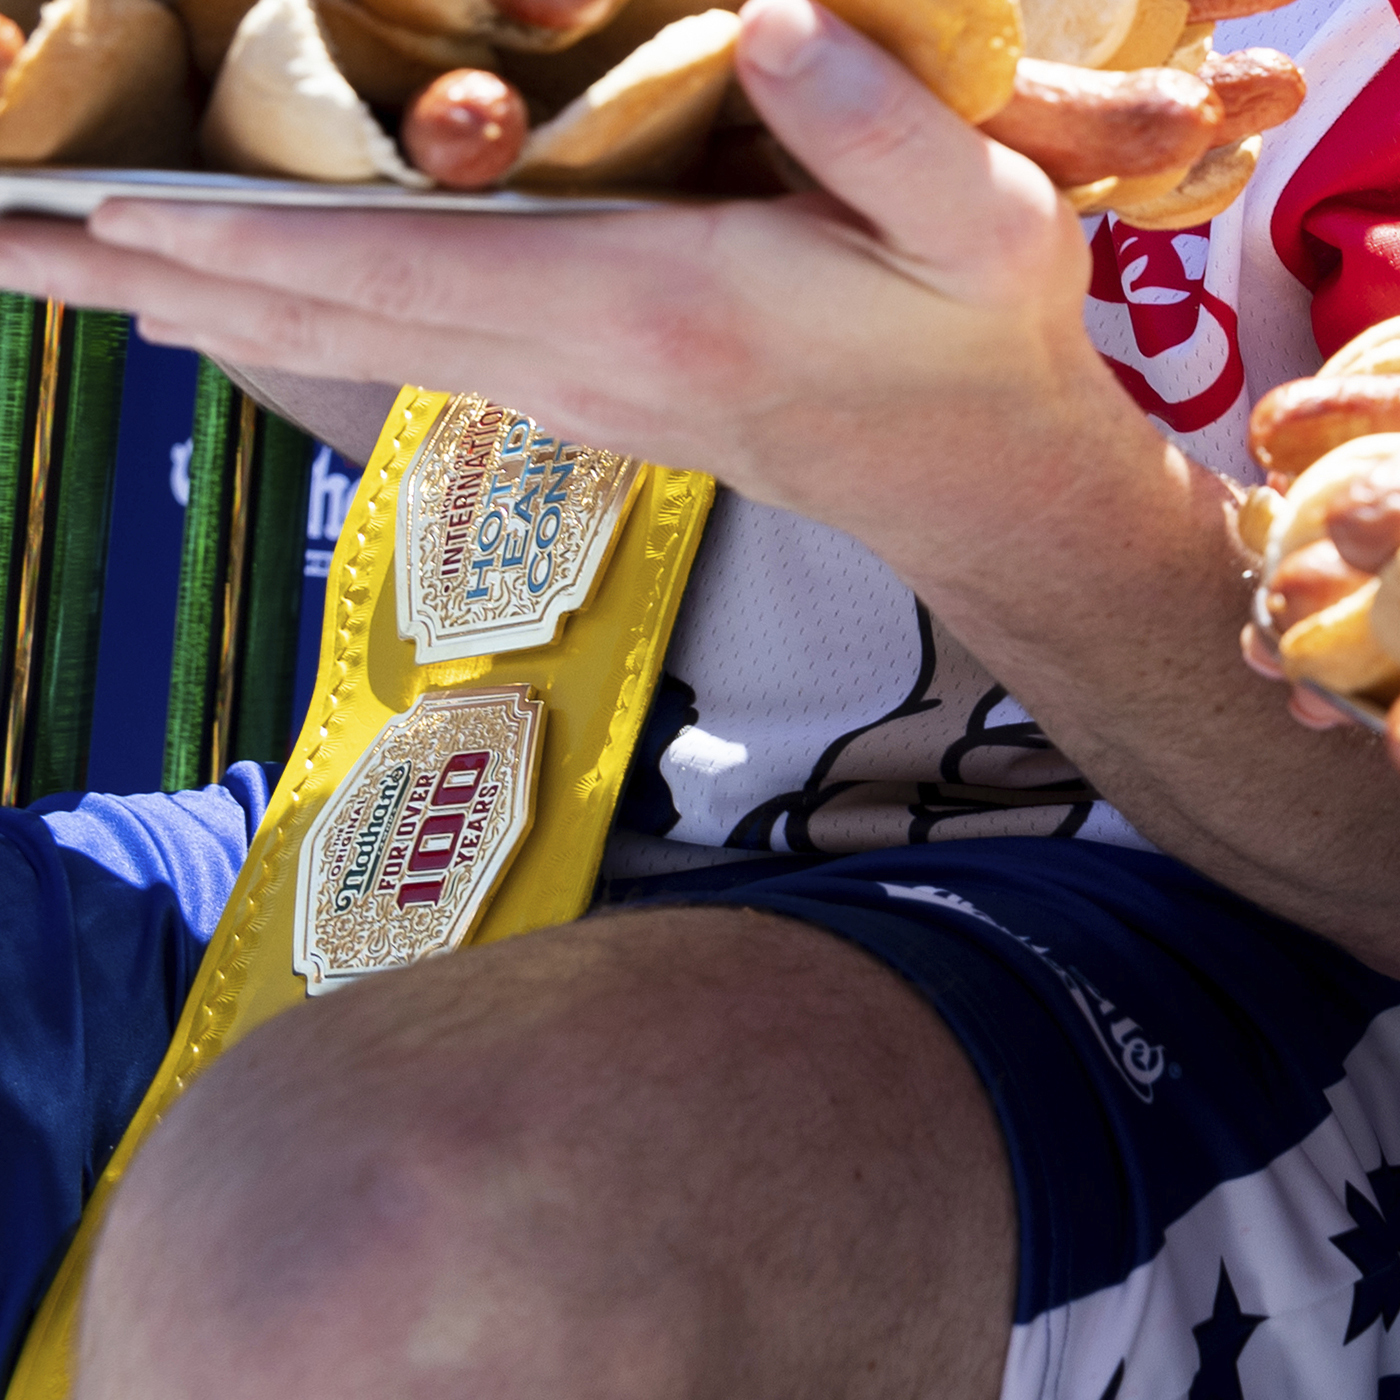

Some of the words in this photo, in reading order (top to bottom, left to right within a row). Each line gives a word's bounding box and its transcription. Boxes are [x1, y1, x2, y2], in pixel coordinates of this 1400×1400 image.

[466, 473, 513, 600] HOT
[331, 796, 368, 878] ORIGINAL
[334, 762, 408, 913] Nathan's
[379, 841, 411, 891] FOR
[396, 772, 437, 838] OVER
[396, 750, 491, 912] 100
[453, 783, 499, 869] YEARS
